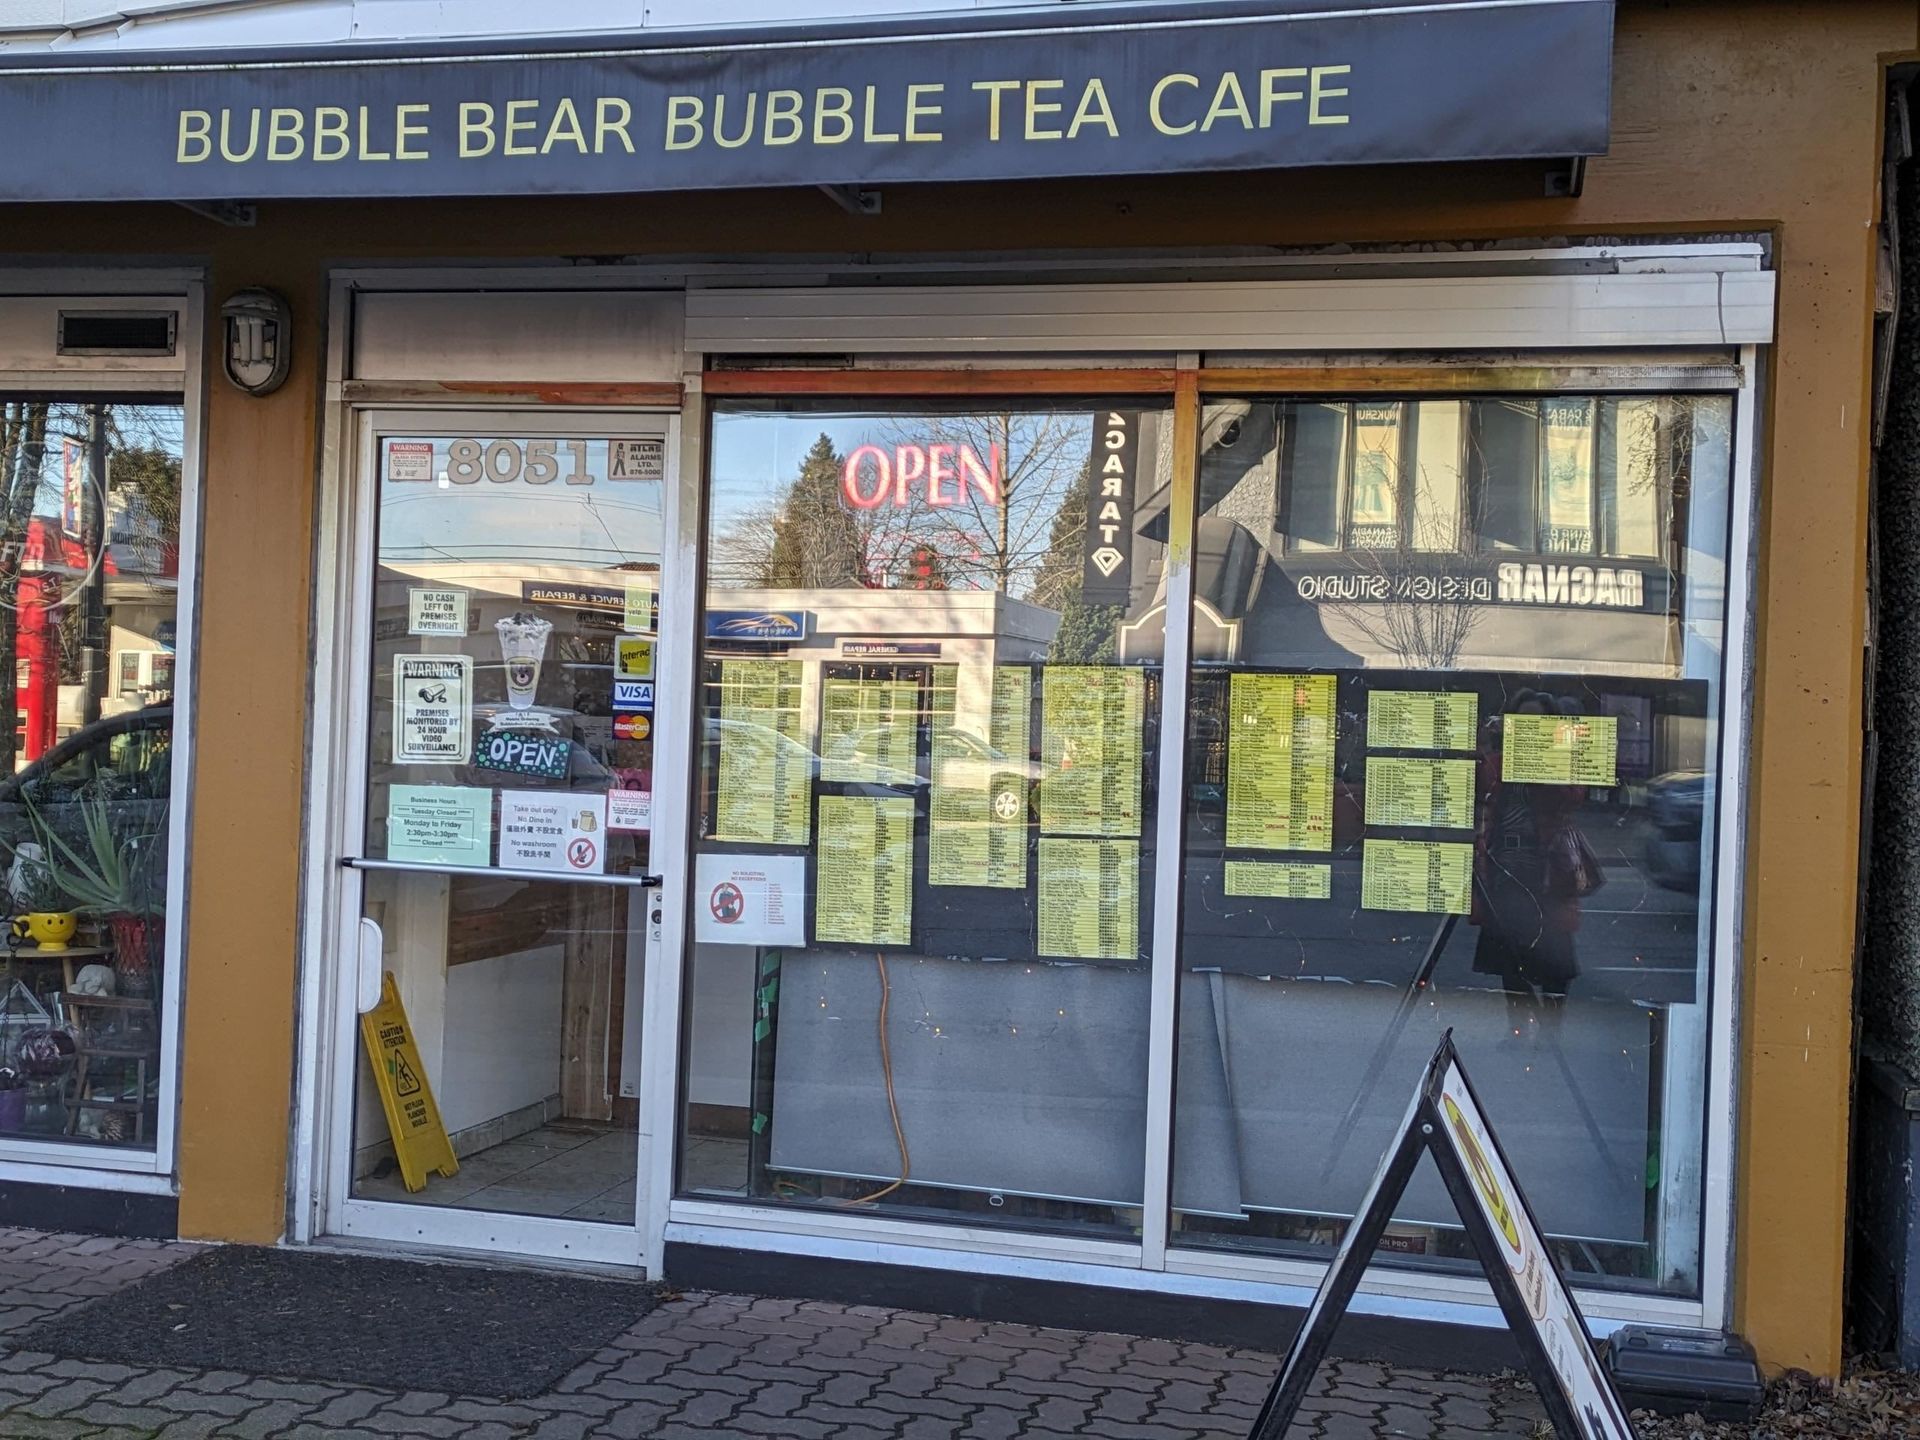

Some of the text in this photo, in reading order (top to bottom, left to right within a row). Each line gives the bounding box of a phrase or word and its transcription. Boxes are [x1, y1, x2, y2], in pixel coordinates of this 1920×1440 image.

[177, 64, 1351, 163] BUBBLE BEAR BUBBLE TEA CAFE
[447, 438, 595, 485] 8051
[842, 442, 1000, 510] OPEN
[435, 594, 455, 602] CASH
[424, 603, 454, 611] LEFT ON
[420, 612, 457, 620] PREMISES
[418, 621, 459, 630] OVERNIGHT
[620, 649, 650, 661] Interac
[406, 663, 459, 677] WARNING
[619, 686, 650, 698] VISA
[415, 709, 449, 717] PREMISES
[406, 717, 459, 726] MONITORED BY
[614, 722, 650, 731] MasterCard
[408, 743, 456, 751] SURVEILLANCE
[490, 738, 557, 767] OPEN
[613, 791, 650, 799] WARNING
[411, 808, 435, 816] Tuesday
[543, 807, 558, 815] only
[403, 819, 430, 828] Monday
[440, 820, 462, 829] Friday
[406, 829, 459, 838] 2:30pm-3:30pm
[380, 1025, 404, 1040] CAUTION
[1391, 1240, 1408, 1248] PRO
